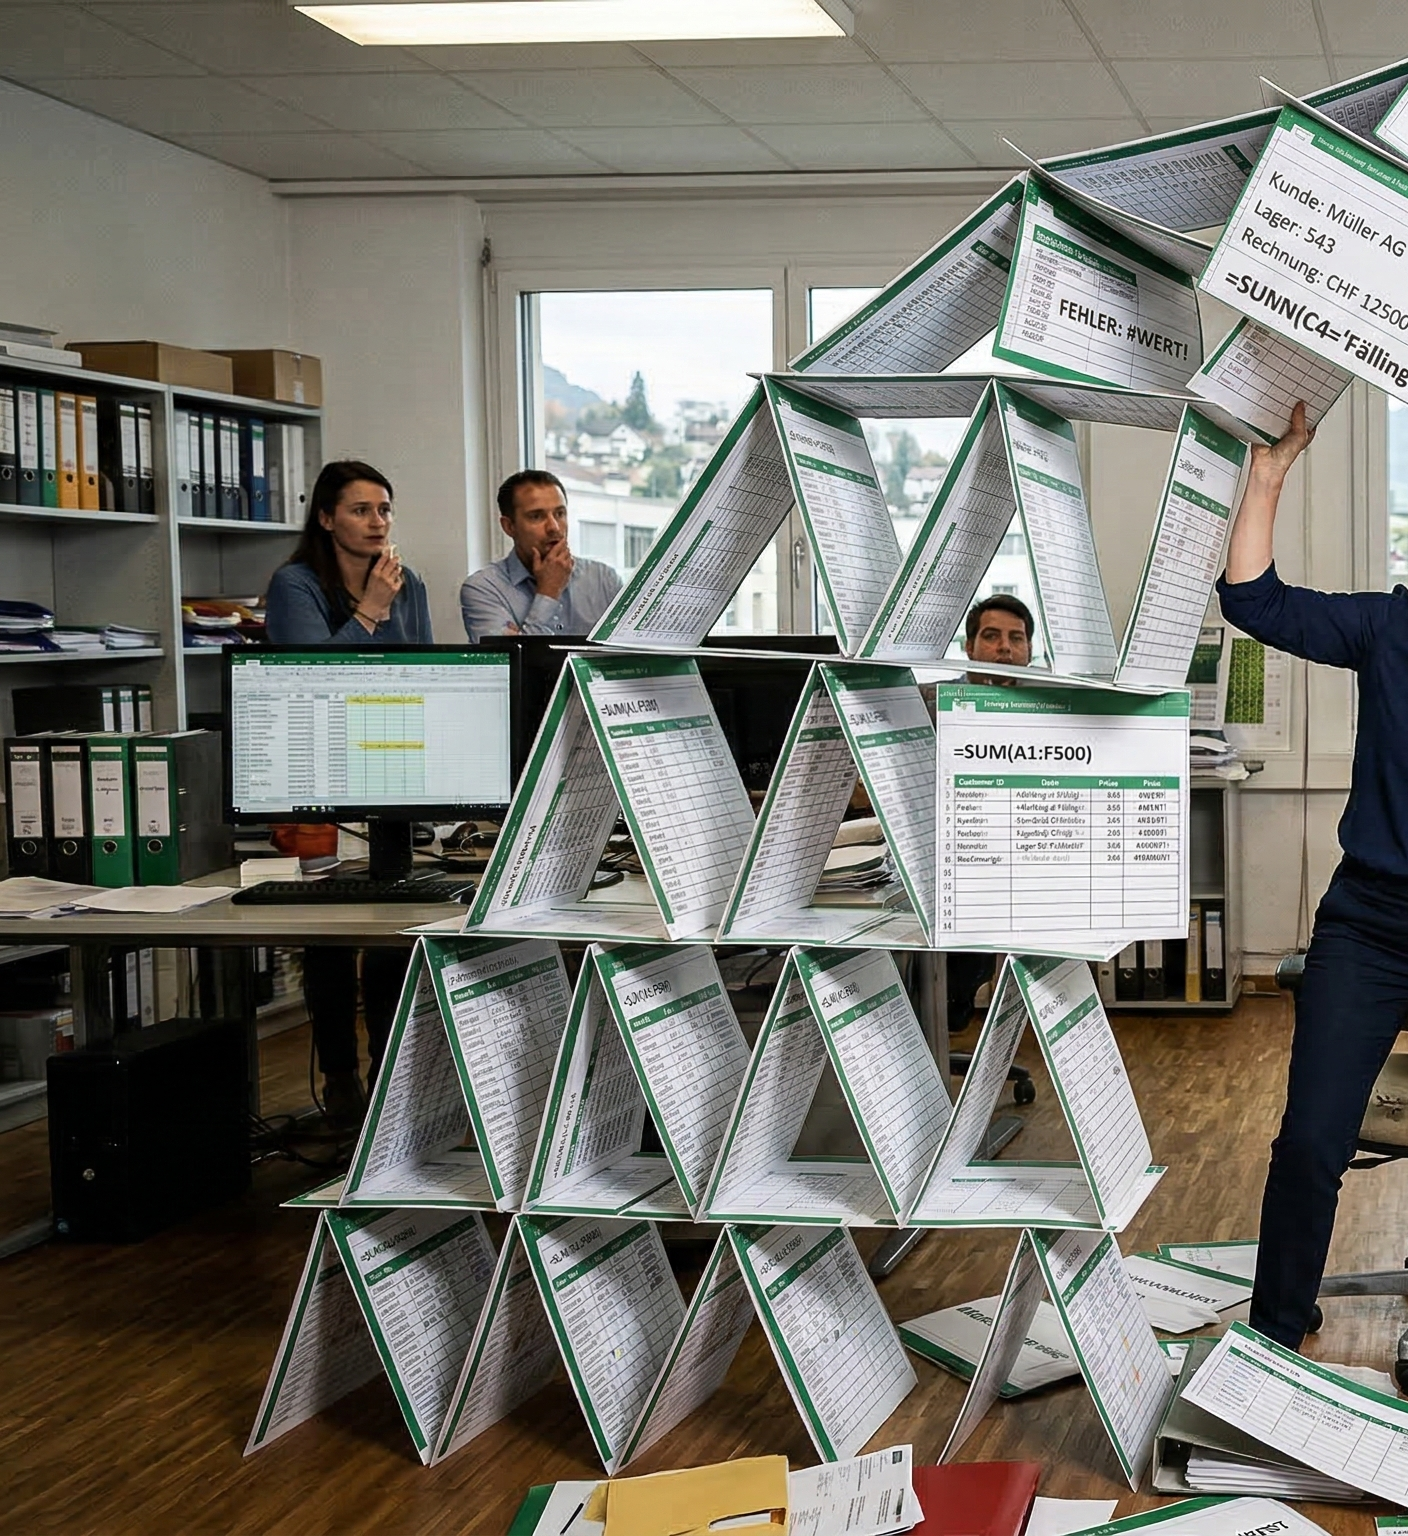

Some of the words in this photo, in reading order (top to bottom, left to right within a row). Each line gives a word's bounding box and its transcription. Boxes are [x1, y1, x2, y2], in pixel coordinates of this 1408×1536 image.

[1253, 199, 1303, 239] Lager:
[1302, 226, 1336, 255] 543
[1268, 170, 1326, 213] Kunde:
[1326, 203, 1380, 242] Müller
[1378, 235, 1407, 258] AG
[1241, 226, 1324, 284] Rechnung:
[1326, 274, 1361, 301] CHF
[1059, 299, 1124, 337] FEHLER:
[1126, 323, 1189, 361] #WERT!
[953, 743, 1092, 765] =SUM(A1:F500)
